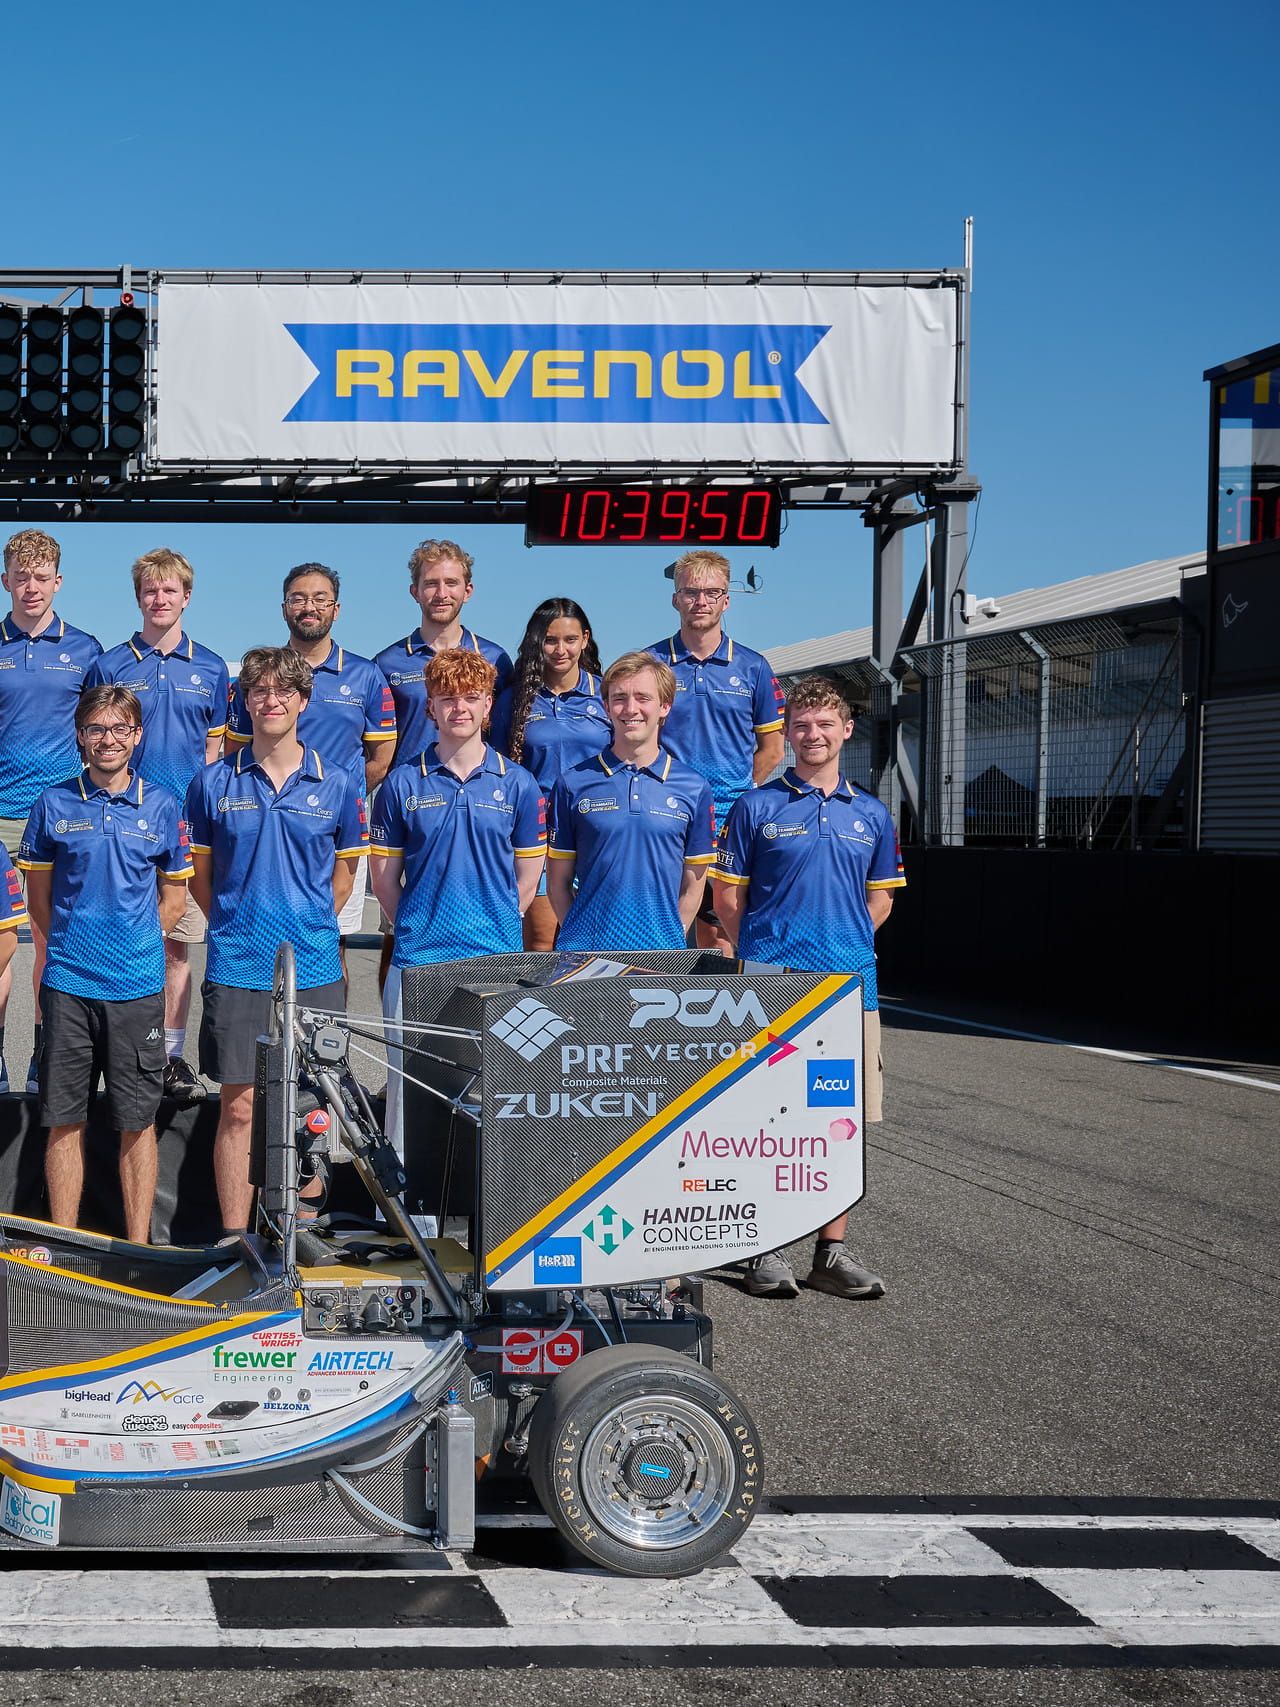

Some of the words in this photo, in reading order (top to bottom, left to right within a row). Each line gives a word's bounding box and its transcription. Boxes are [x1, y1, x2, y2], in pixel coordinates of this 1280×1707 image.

[558, 489, 772, 541] 10:39:50
[629, 988, 771, 1028] PCM
[561, 1043, 634, 1074] PRF
[643, 1041, 757, 1062] VECTOR
[562, 1077, 618, 1090] Composite
[619, 1075, 668, 1087] Materials
[812, 1078, 850, 1091] ACCU
[681, 1128, 828, 1159] Mewburn
[774, 1162, 828, 1193] Ellis
[682, 1179, 737, 1192] RELEC
[642, 1202, 757, 1226] HANDLING
[643, 1222, 759, 1244] CONCEPTS
[651, 1245, 689, 1253] ENGINEERED
[691, 1242, 723, 1250] HANDLING
[725, 1240, 760, 1249] SOLUTIONS
[252, 1332, 302, 1341] CURTISS-
[260, 1339, 303, 1348] WRIGHT
[213, 1345, 297, 1368] frewer
[306, 1351, 394, 1371] AIRTECH
[214, 1373, 294, 1385] Engineering
[64, 1389, 111, 1403] bigHead
[173, 1393, 205, 1404] acre
[263, 1401, 311, 1411] BELZONA
[123, 1414, 167, 1424] demon
[122, 1422, 169, 1432] tweeks
[172, 1421, 222, 1433] easycomposites
